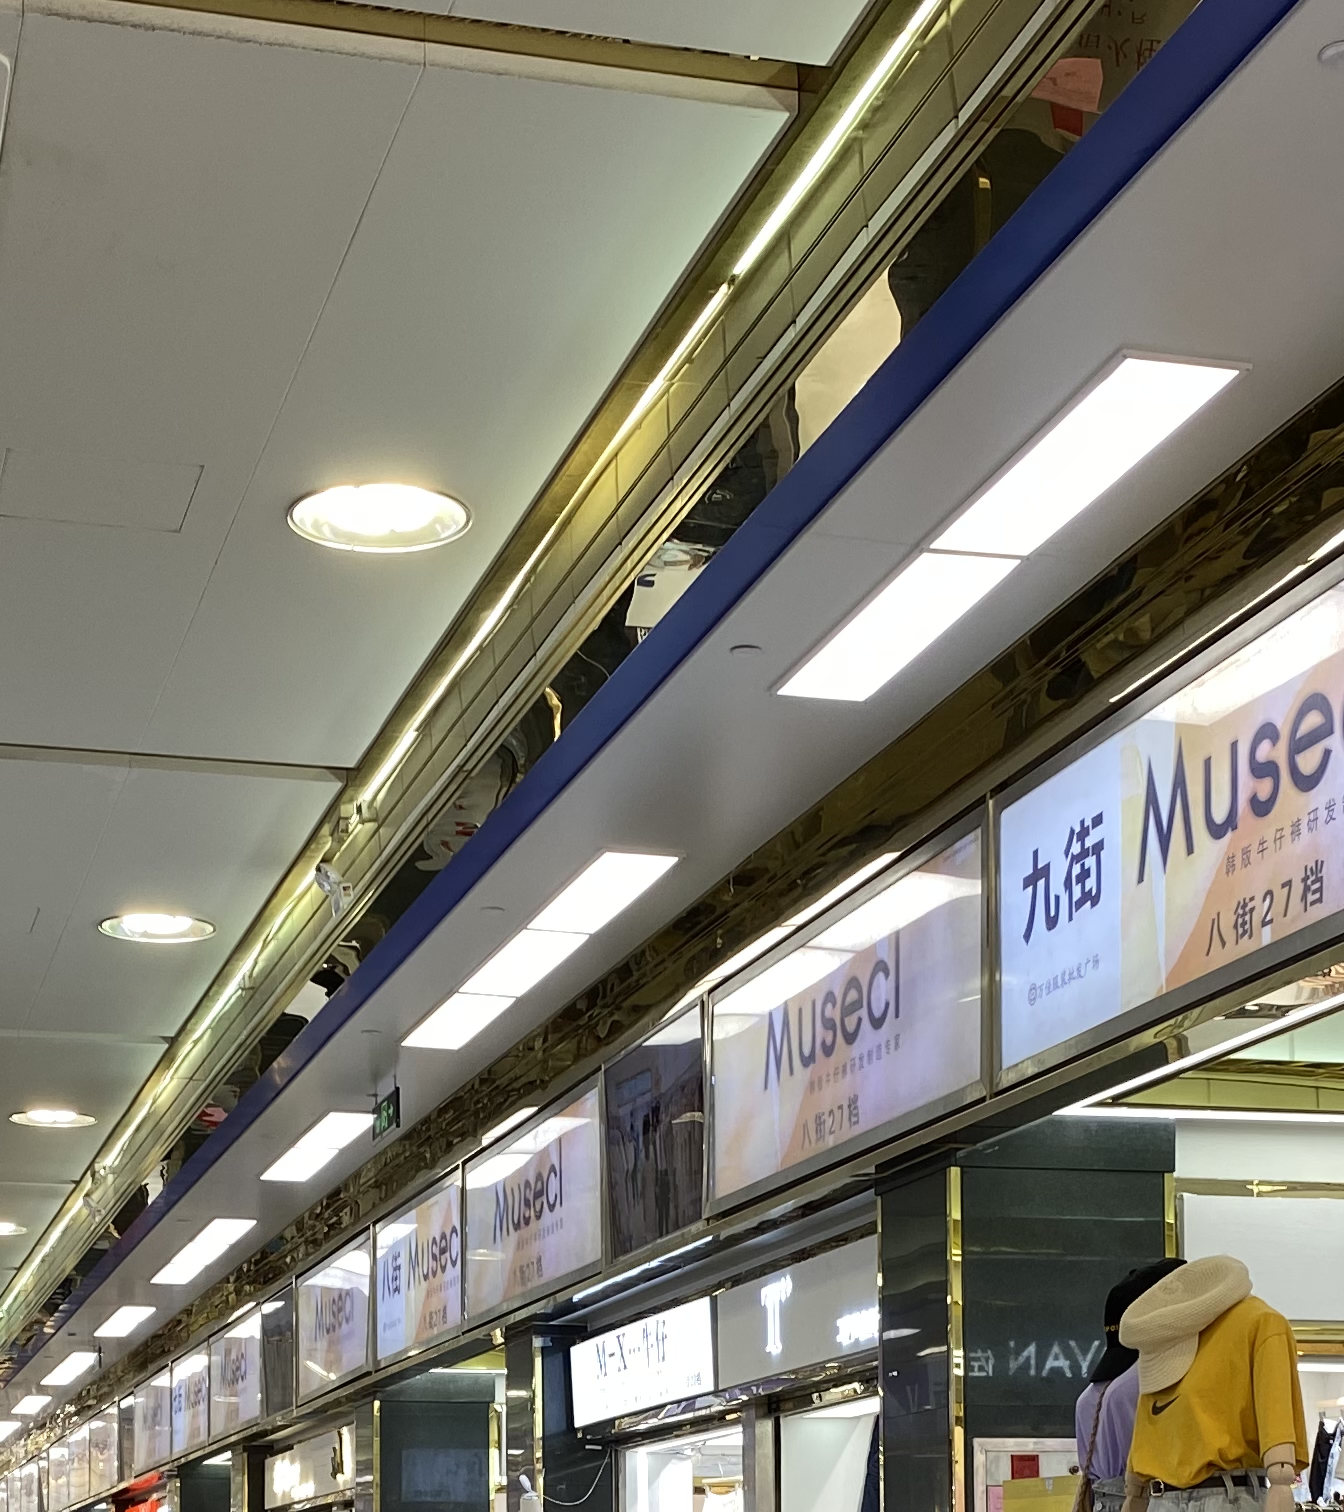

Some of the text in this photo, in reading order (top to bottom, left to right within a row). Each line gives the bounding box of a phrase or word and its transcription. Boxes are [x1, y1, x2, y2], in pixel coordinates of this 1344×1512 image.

[1022, 811, 1105, 946] 九街
[1206, 858, 1325, 957] 八街27档
[763, 931, 901, 1091] Musecl
[801, 1094, 860, 1149] 八街27档
[494, 1137, 564, 1244] Musecl
[381, 1250, 402, 1304] 八街
